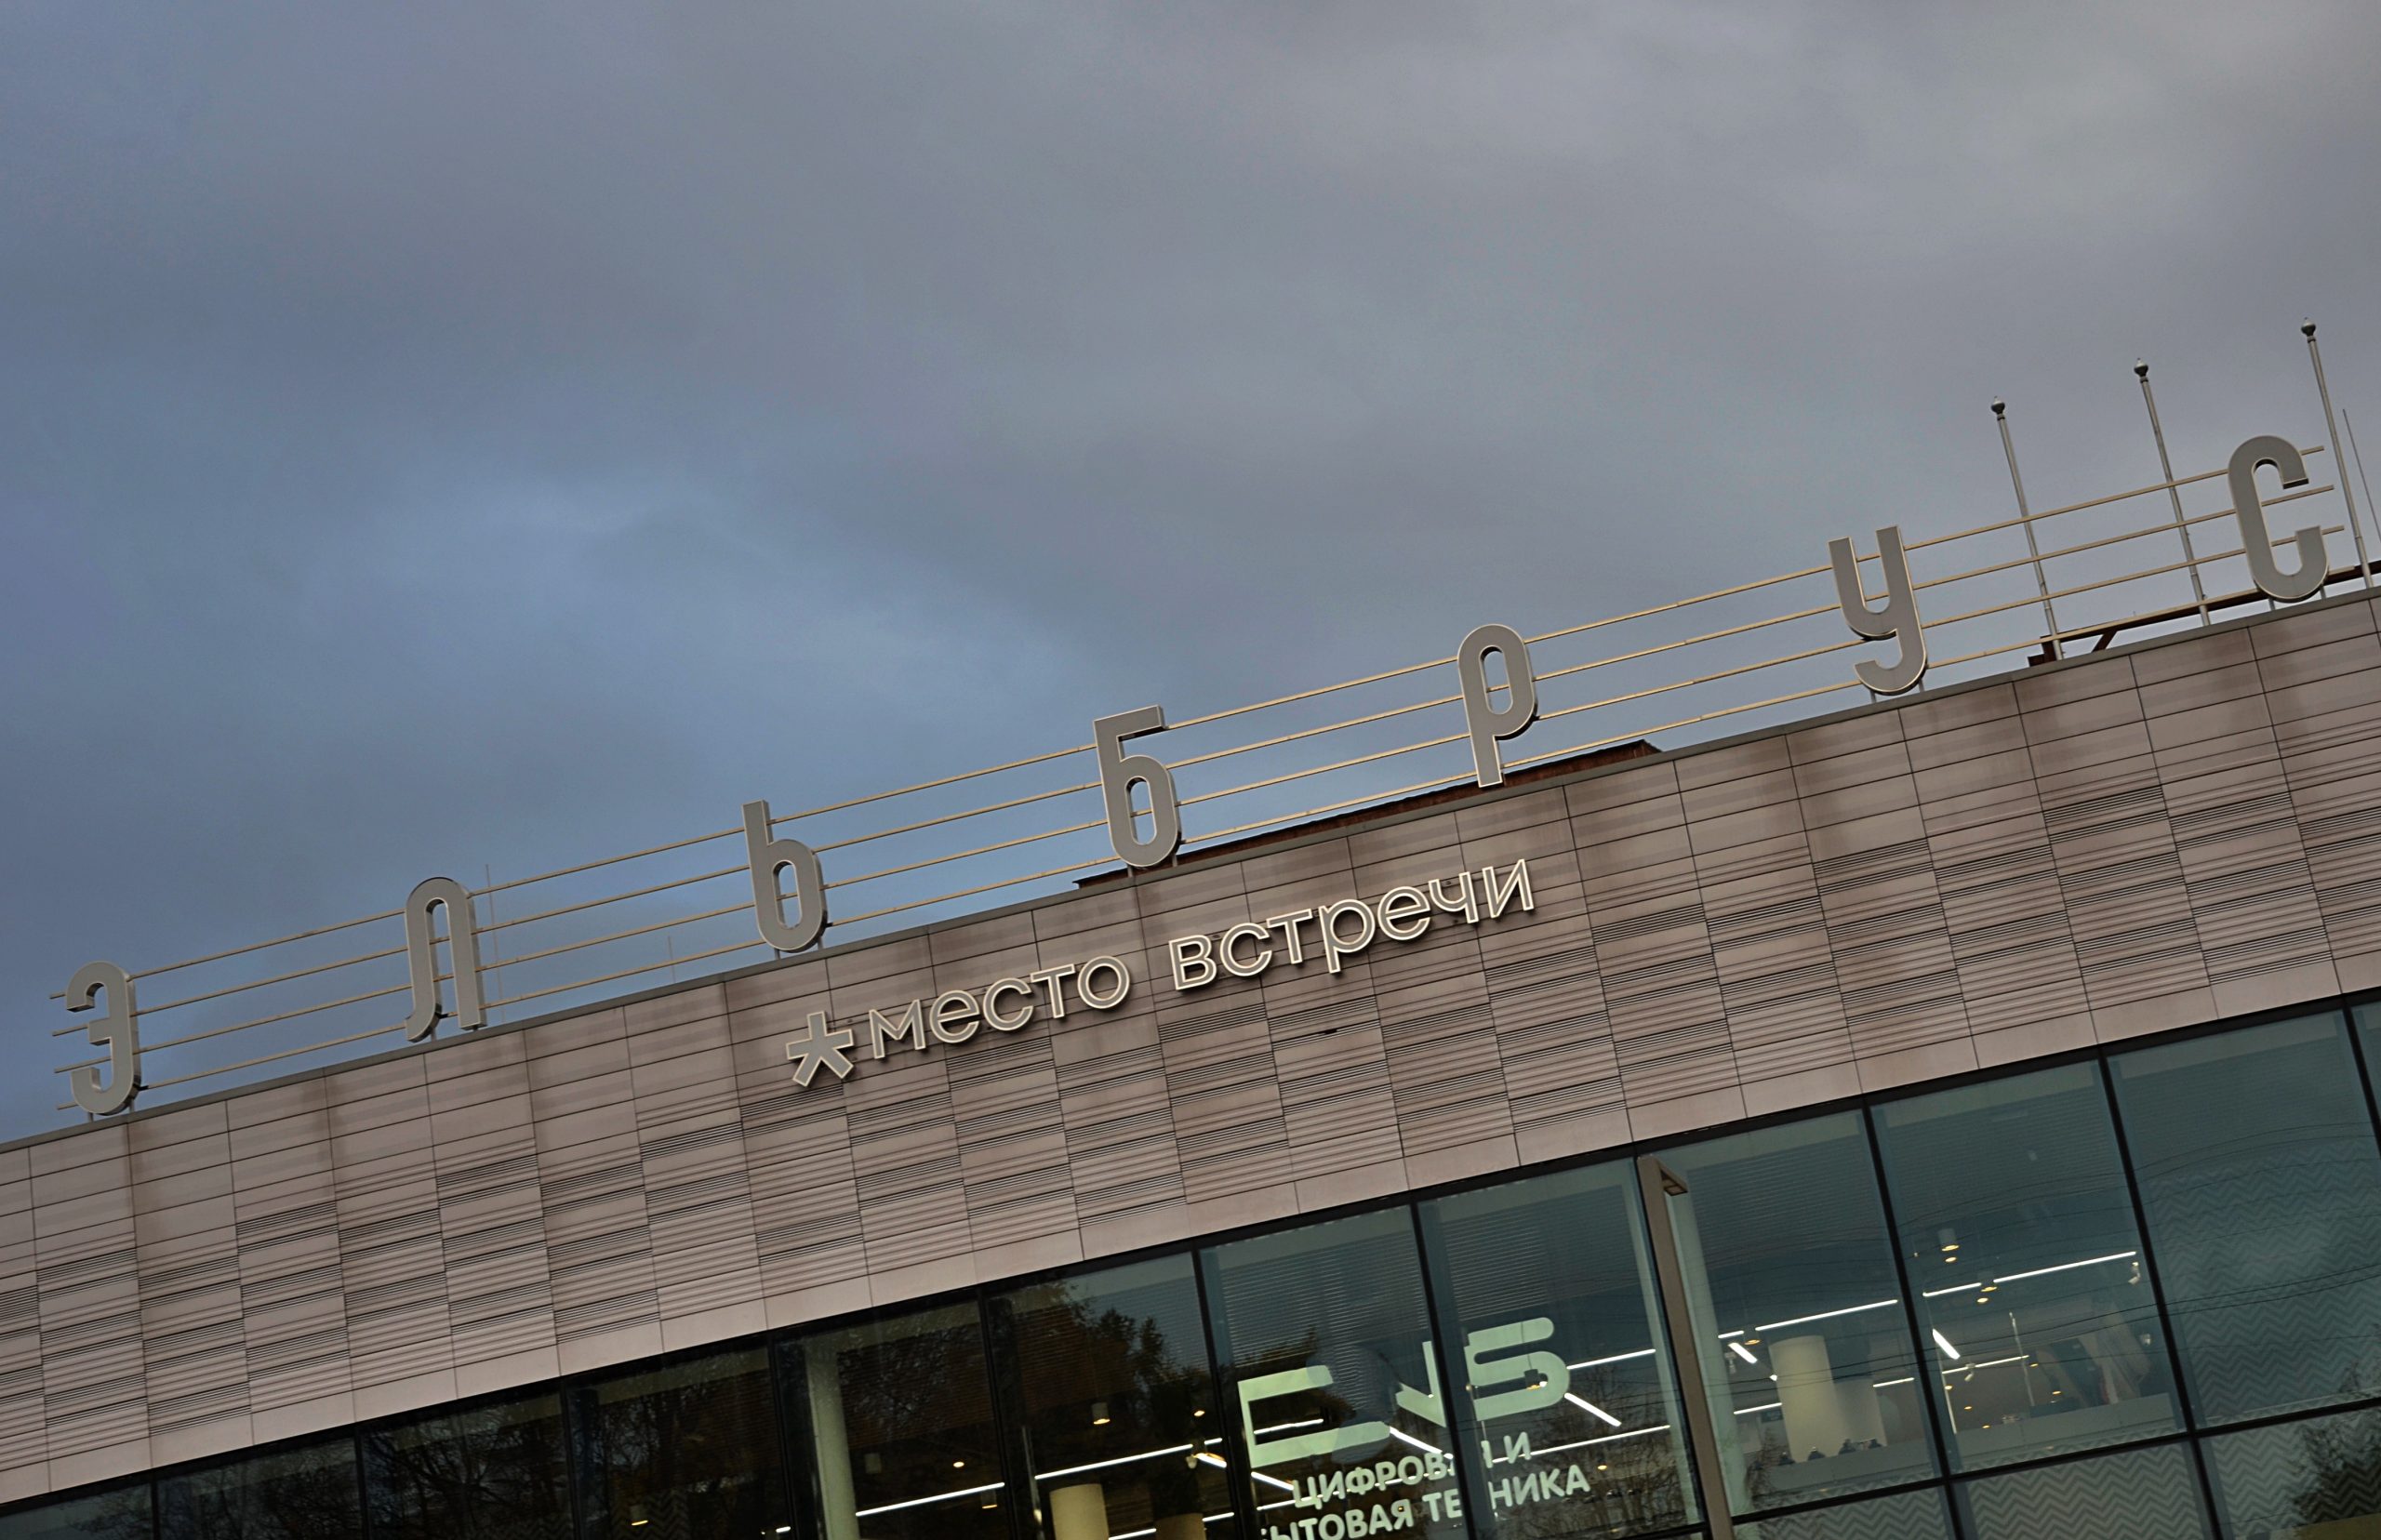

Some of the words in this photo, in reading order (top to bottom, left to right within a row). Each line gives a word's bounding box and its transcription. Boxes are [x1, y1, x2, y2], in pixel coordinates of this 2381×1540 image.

[869, 956, 1131, 1059] место
[1168, 858, 1535, 990] встречи
[1261, 1499, 1414, 1540] ЫТОВАЯ
[1422, 1465, 1591, 1521] ТЕНИКА
[1293, 1440, 1493, 1510] ЦИФРОВ
[1504, 1431, 1531, 1464] И
